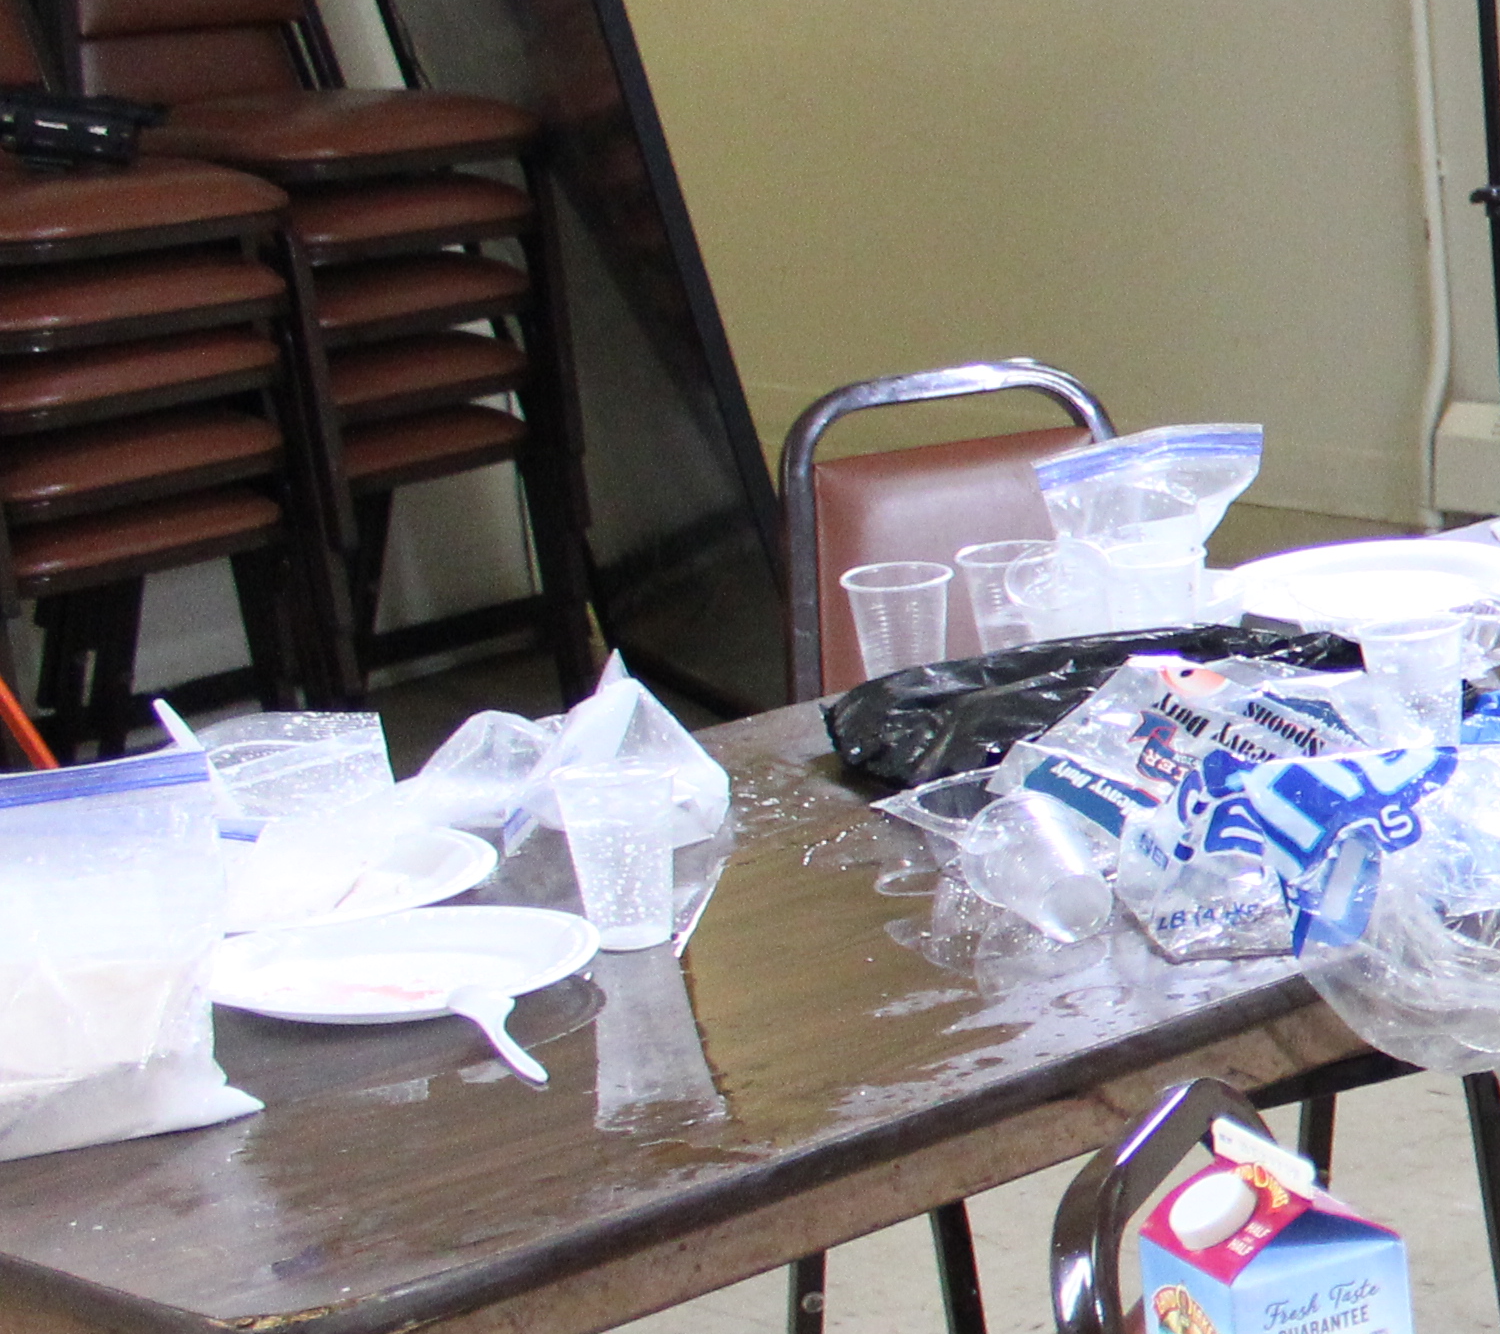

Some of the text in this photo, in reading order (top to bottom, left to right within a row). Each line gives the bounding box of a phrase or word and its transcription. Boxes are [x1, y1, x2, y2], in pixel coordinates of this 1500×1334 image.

[1152, 691, 1211, 739] Duty
[1243, 701, 1327, 758] Spoons
[1050, 760, 1093, 789] Duty
[1226, 1238, 1255, 1256] HALF
[1244, 1222, 1272, 1239] HALF
[1263, 1278, 1381, 1331] Fresh Taste
